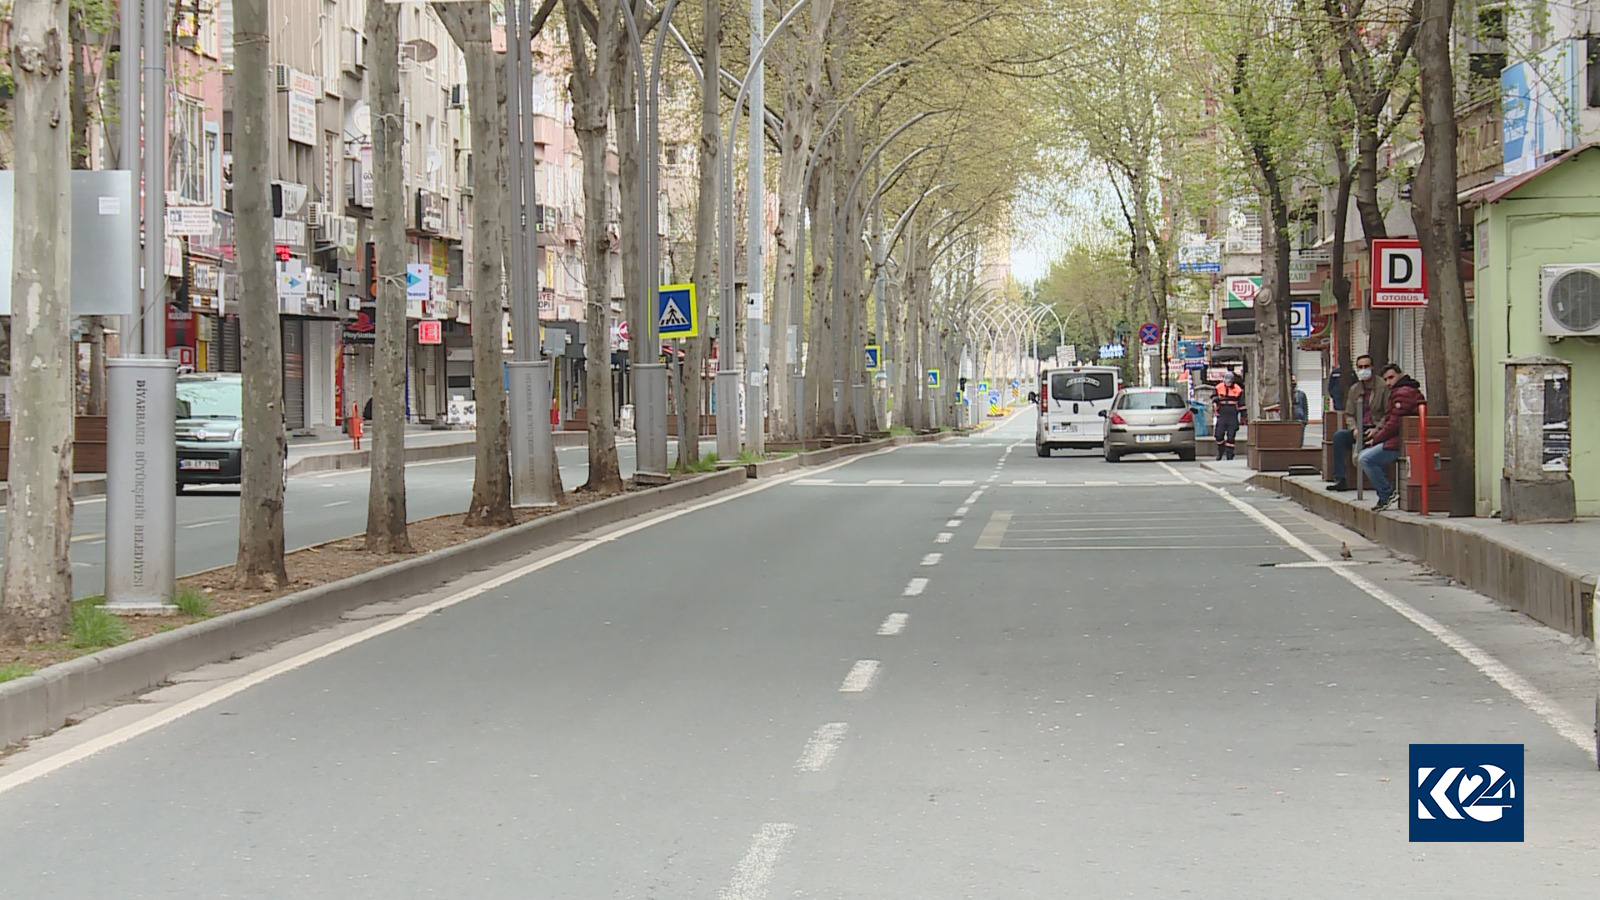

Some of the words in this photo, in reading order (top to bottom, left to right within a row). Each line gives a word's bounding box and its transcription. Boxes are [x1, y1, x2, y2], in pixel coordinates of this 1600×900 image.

[1388, 253, 1414, 284] D
[1380, 293, 1419, 302] OTOBÜS
[343, 331, 376, 341] PlayStatio
[135, 379, 148, 445] DİYARBAKIR
[131, 450, 147, 520] BÜYÜKŞEHİR
[133, 524, 147, 588] BELEDİYESİ
